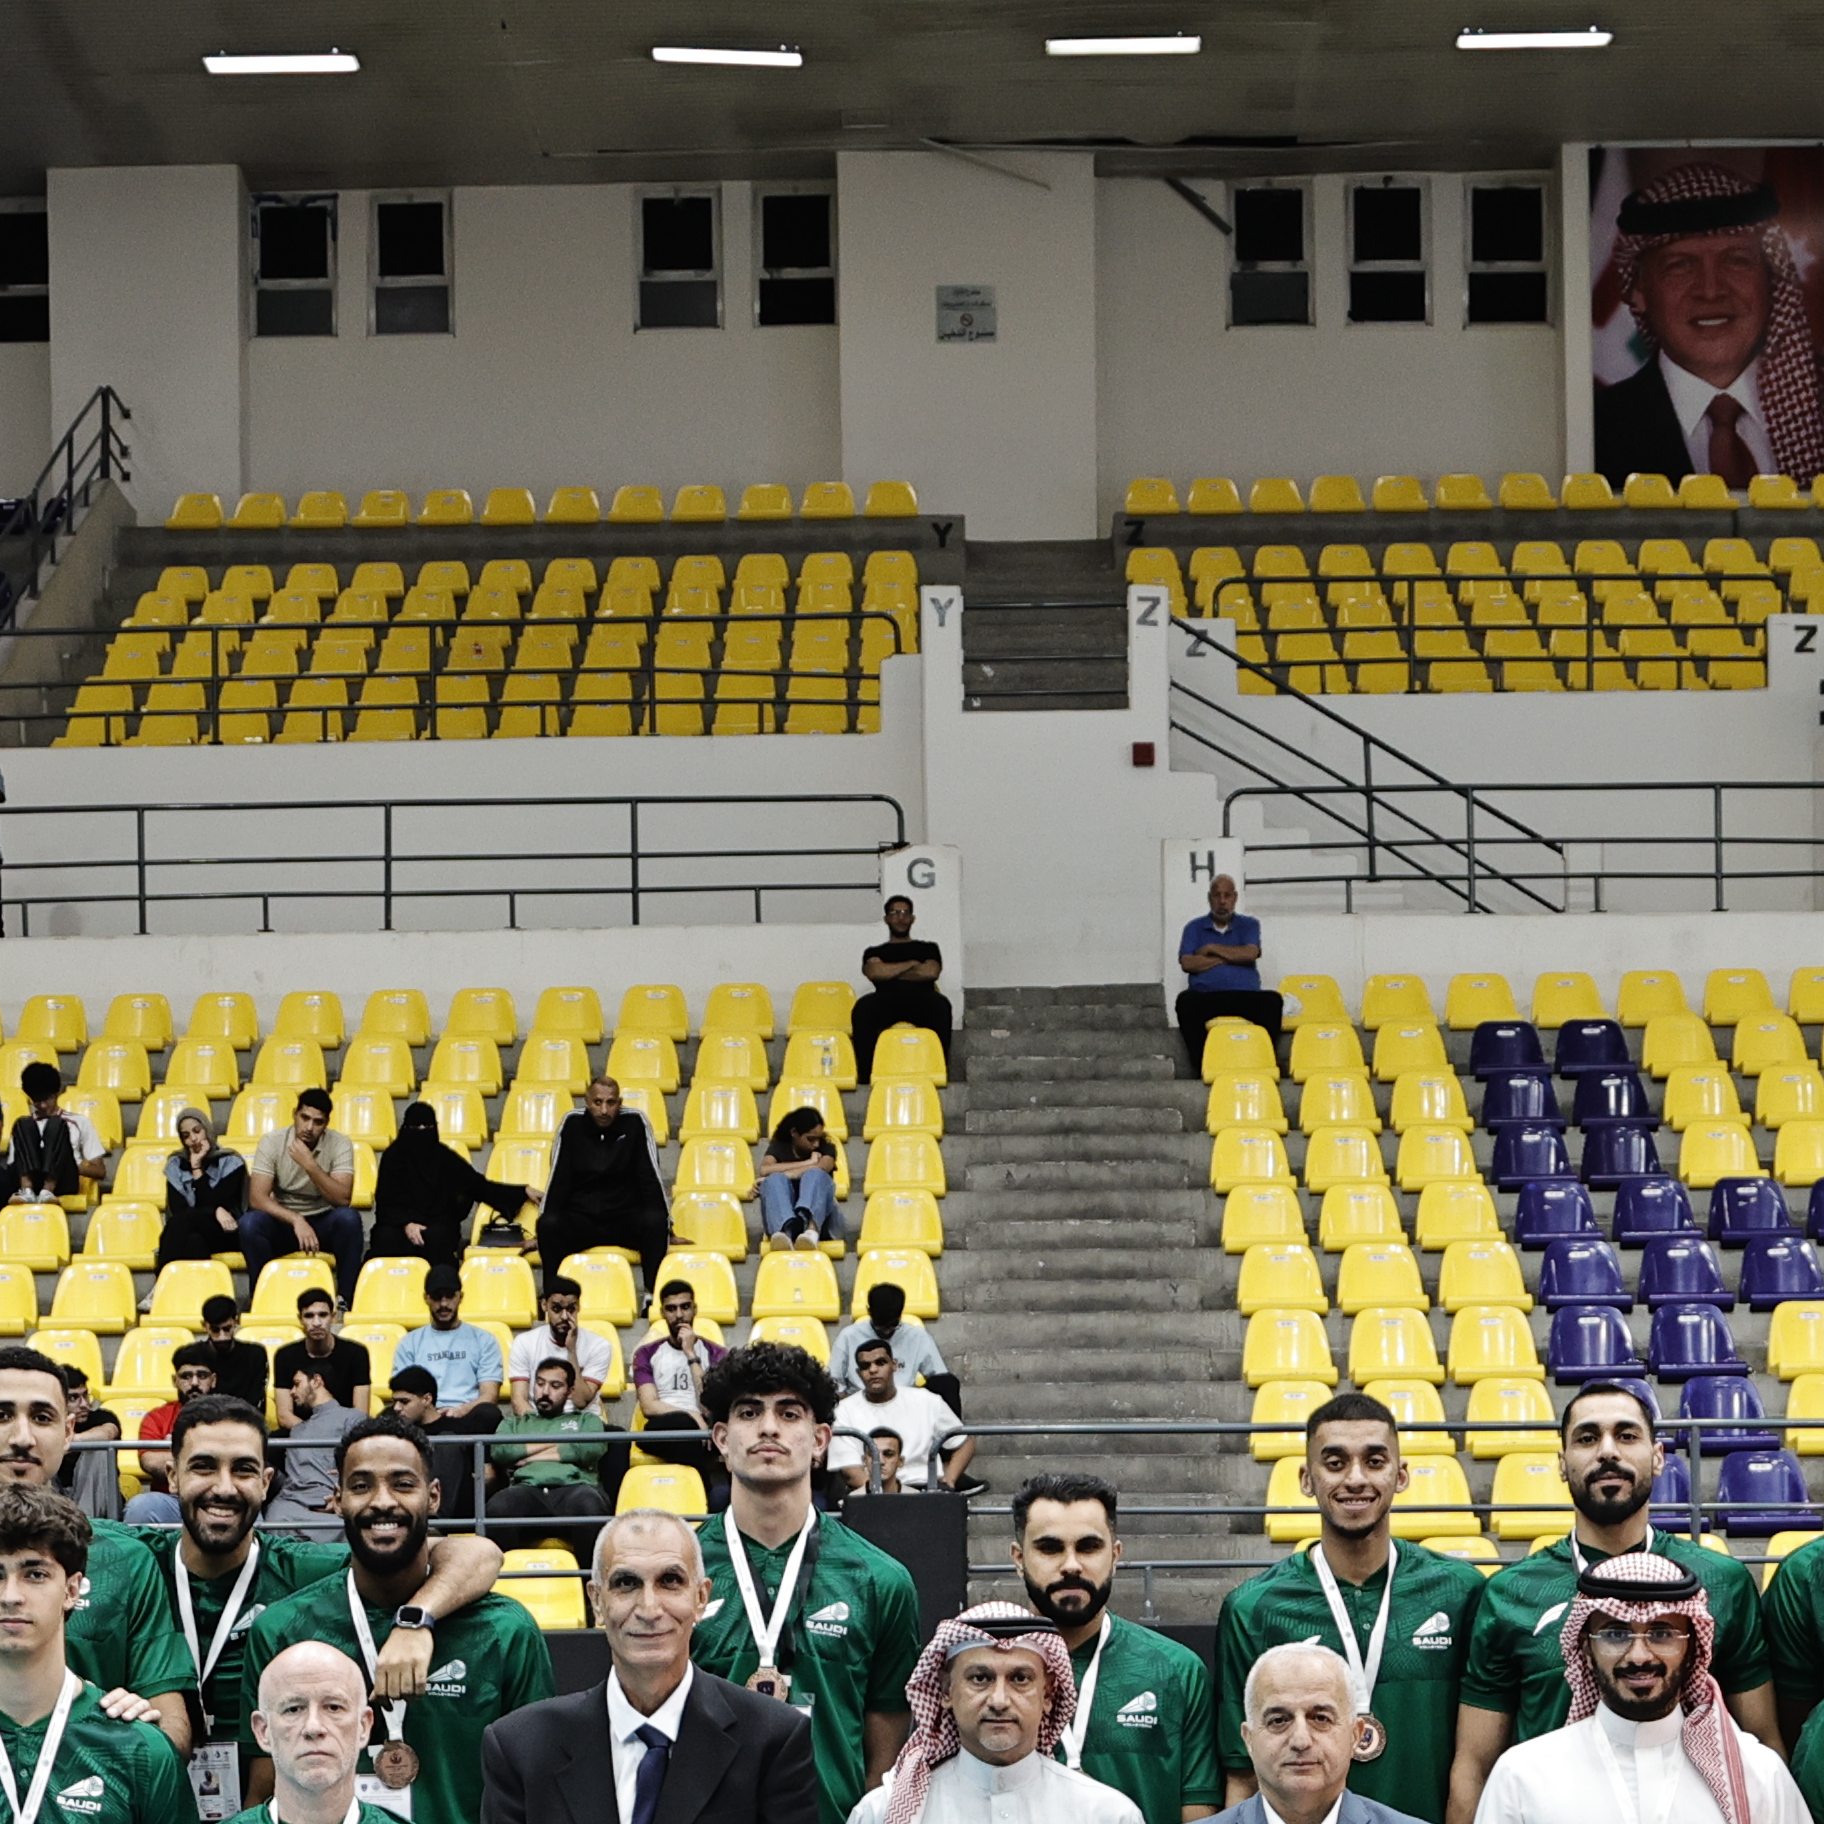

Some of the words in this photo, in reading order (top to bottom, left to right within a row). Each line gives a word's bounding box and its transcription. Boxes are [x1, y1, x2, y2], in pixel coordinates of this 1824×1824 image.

[931, 522, 953, 548] Y
[1124, 520, 1145, 546] Z
[929, 597, 955, 627] Y
[1136, 596, 1161, 626] Z
[1794, 624, 1818, 653] Z
[907, 857, 936, 889] G
[1189, 850, 1215, 883] H
[672, 1373, 688, 1391] 13
[805, 1620, 848, 1635] SAUDI
[1412, 1637, 1452, 1645] SAUDI
[424, 1683, 466, 1694] SAUDI
[1116, 1714, 1158, 1725] SAUDI
[56, 1795, 102, 1812] SAUDI
